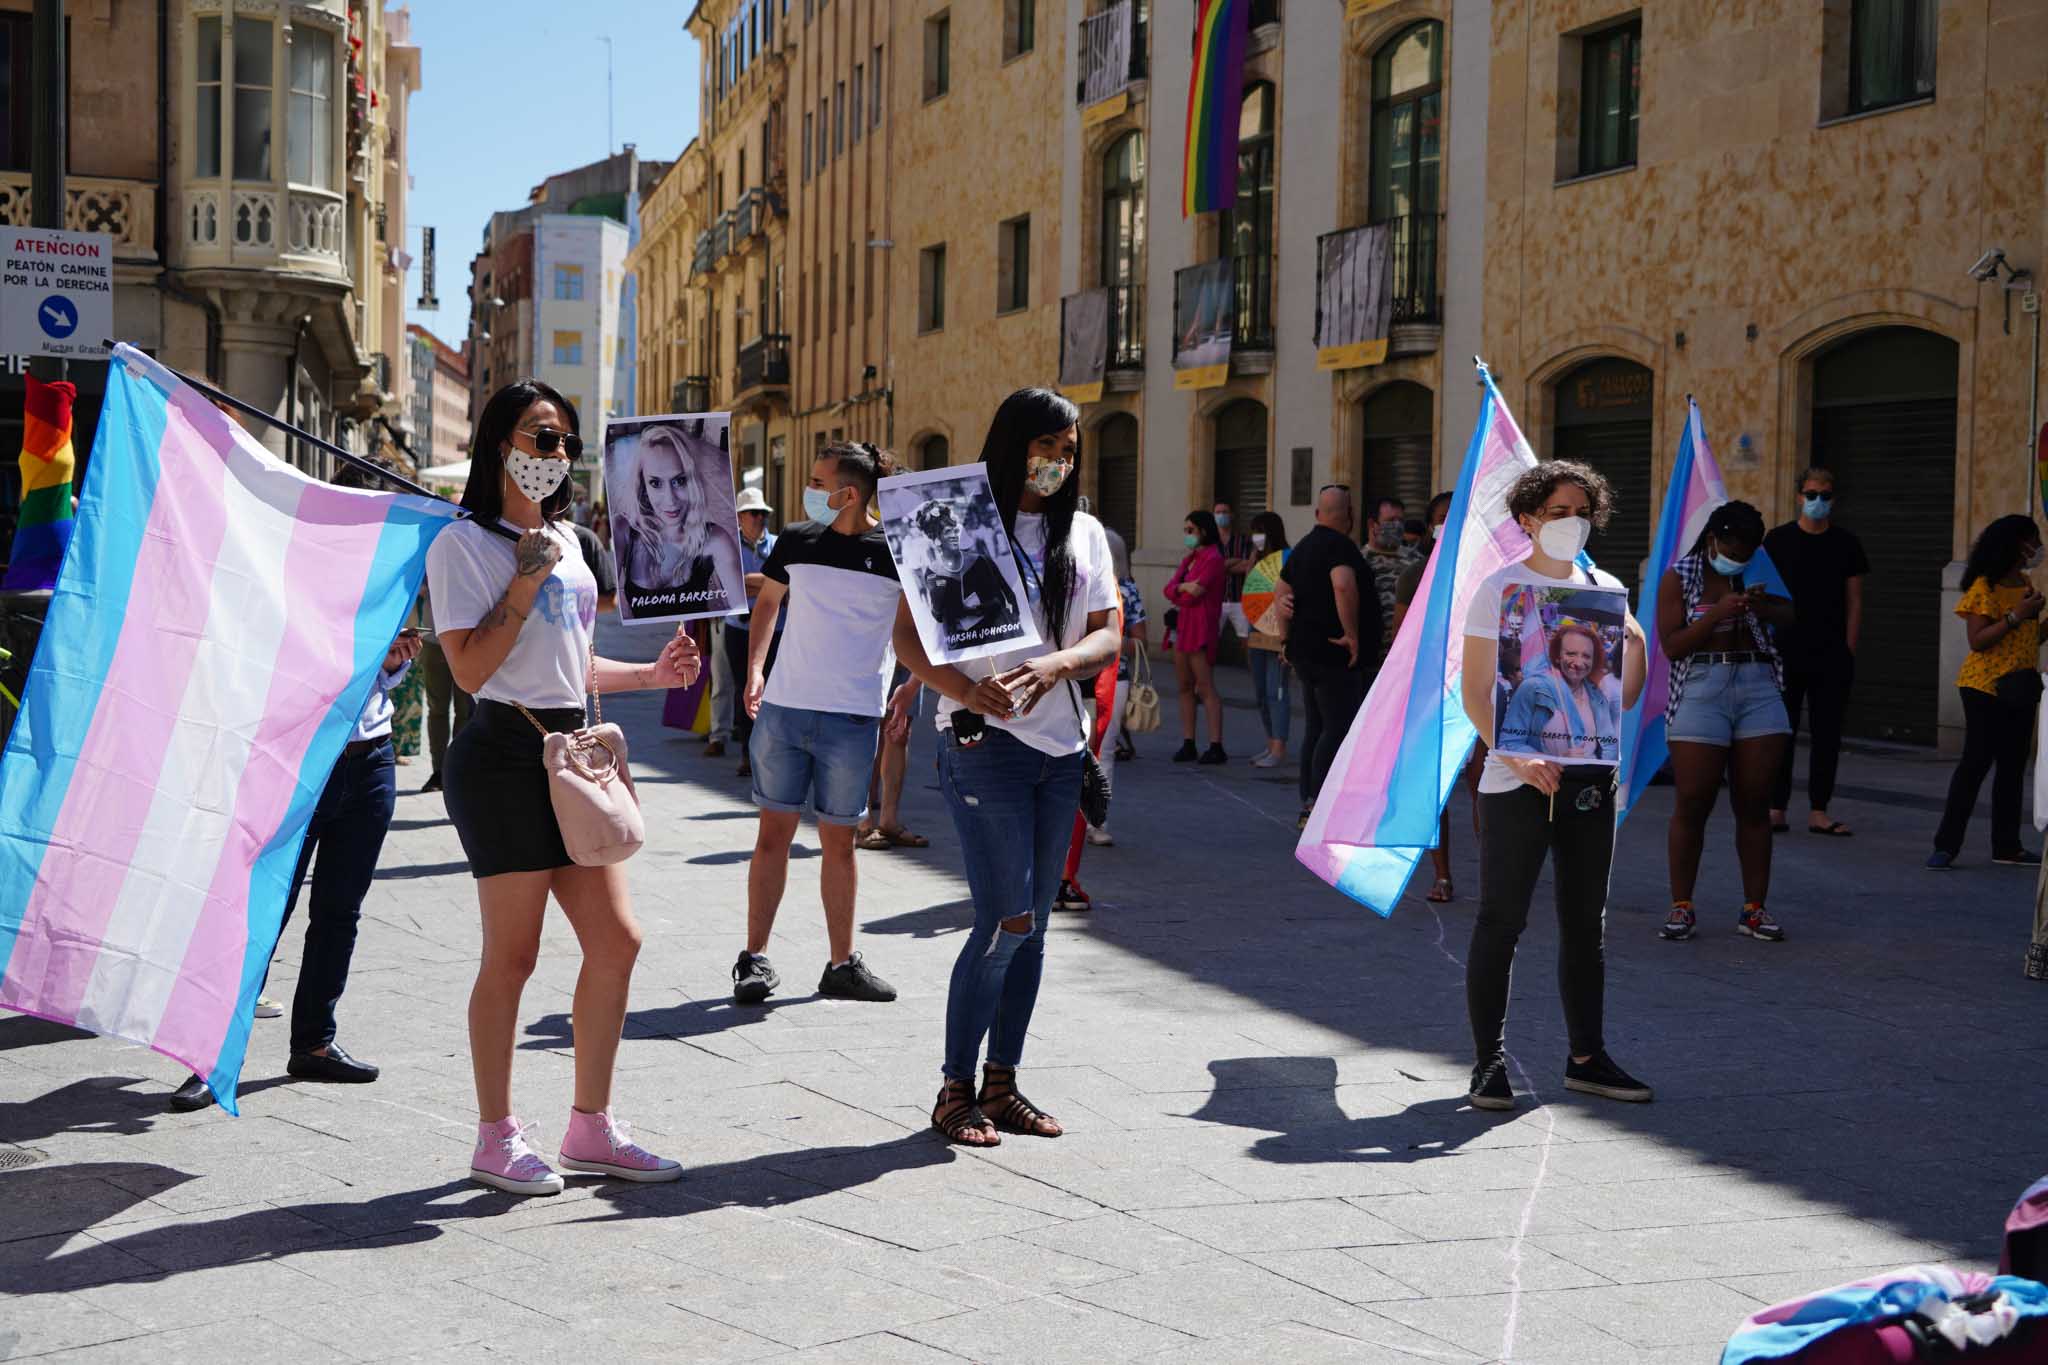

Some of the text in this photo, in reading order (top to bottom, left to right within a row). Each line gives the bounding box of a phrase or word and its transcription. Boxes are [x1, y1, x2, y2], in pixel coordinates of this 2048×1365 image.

[15, 239, 100, 258] ATENCIÓN
[7, 259, 107, 278] PEATÓN CAMINE
[4, 274, 110, 292] POR LA DERECHA
[42, 341, 109, 354] Muchas Gracias
[631, 589, 729, 608] PALOMA BARRETO
[943, 623, 1021, 645] MARSHA JOHNSON
[1574, 735, 1619, 744] MONTAÑO
